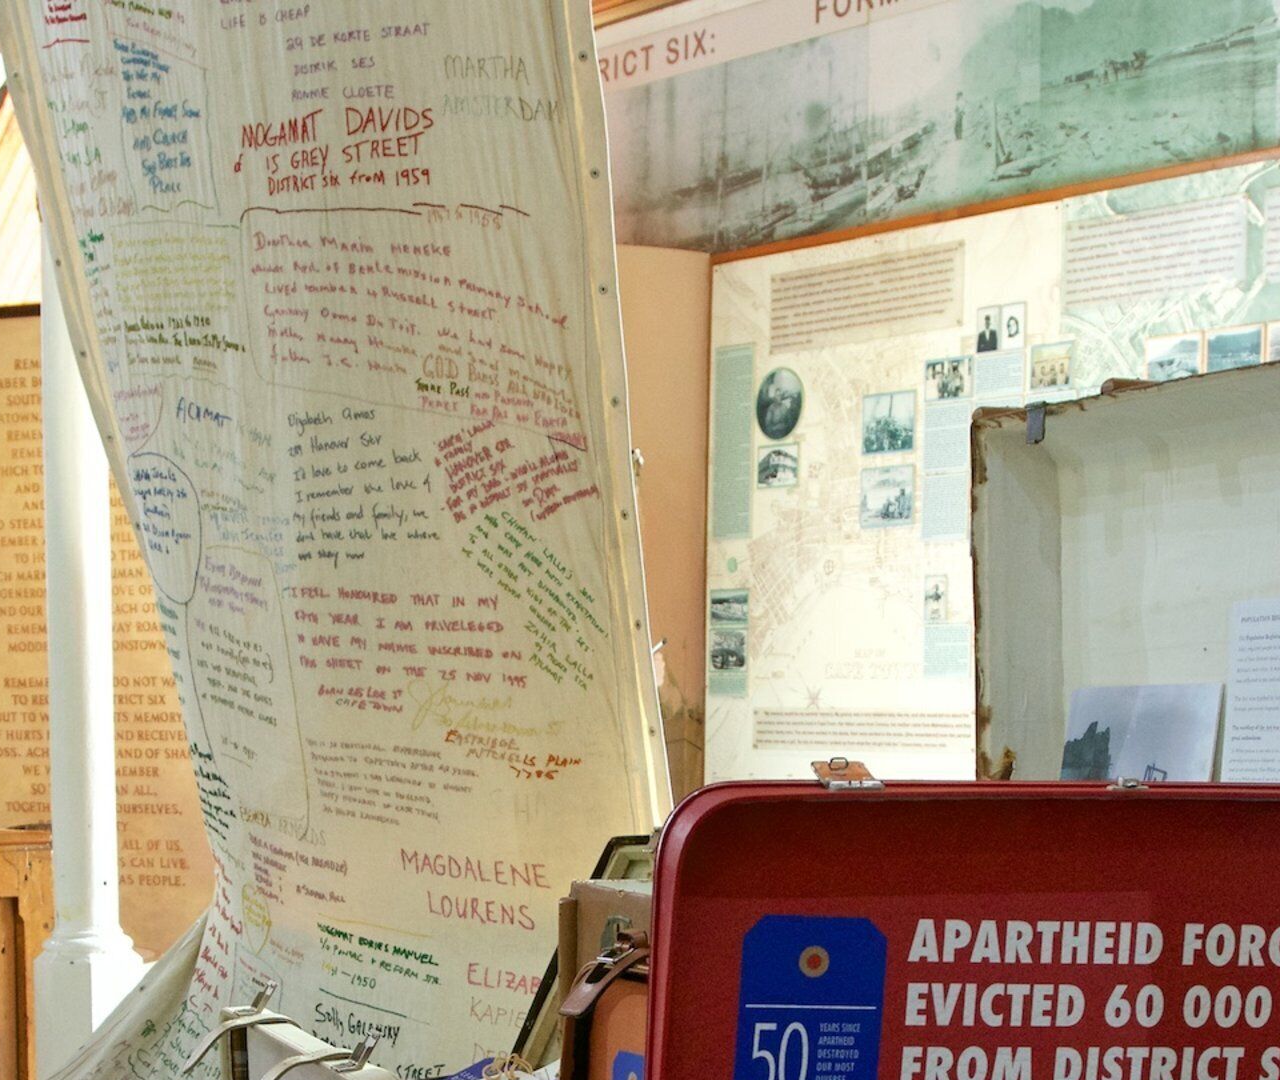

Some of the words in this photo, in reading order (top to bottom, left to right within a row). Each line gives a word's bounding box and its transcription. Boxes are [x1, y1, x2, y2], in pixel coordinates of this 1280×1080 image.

[380, 23, 430, 39] STRAAT
[599, 44, 654, 82] RICT
[666, 28, 716, 65] SIX:
[242, 108, 323, 149] MOGAMAT
[345, 106, 435, 137] DAVIDS
[290, 144, 329, 176] GREY
[342, 131, 425, 165] STREET
[395, 168, 431, 186] 1959
[392, 449, 423, 464] back
[410, 594, 440, 607] THAT
[328, 613, 360, 626] YEAR
[466, 671, 492, 684] NOV
[502, 674, 528, 688] 1995
[400, 848, 552, 889] MAGDALENE
[426, 890, 535, 931] LOURENS
[908, 917, 1164, 966] APARTHEID
[904, 981, 1086, 1028] EVICTED
[1103, 983, 1165, 1028] 60
[1182, 984, 1273, 1029] 000
[819, 1022, 840, 1033] YEARS
[841, 1023, 861, 1033] SINCE
[817, 1036, 855, 1046] APARTHEID
[817, 1049, 859, 1059] DESTROYED
[816, 1062, 832, 1072] OUR
[834, 1062, 855, 1072] MOST
